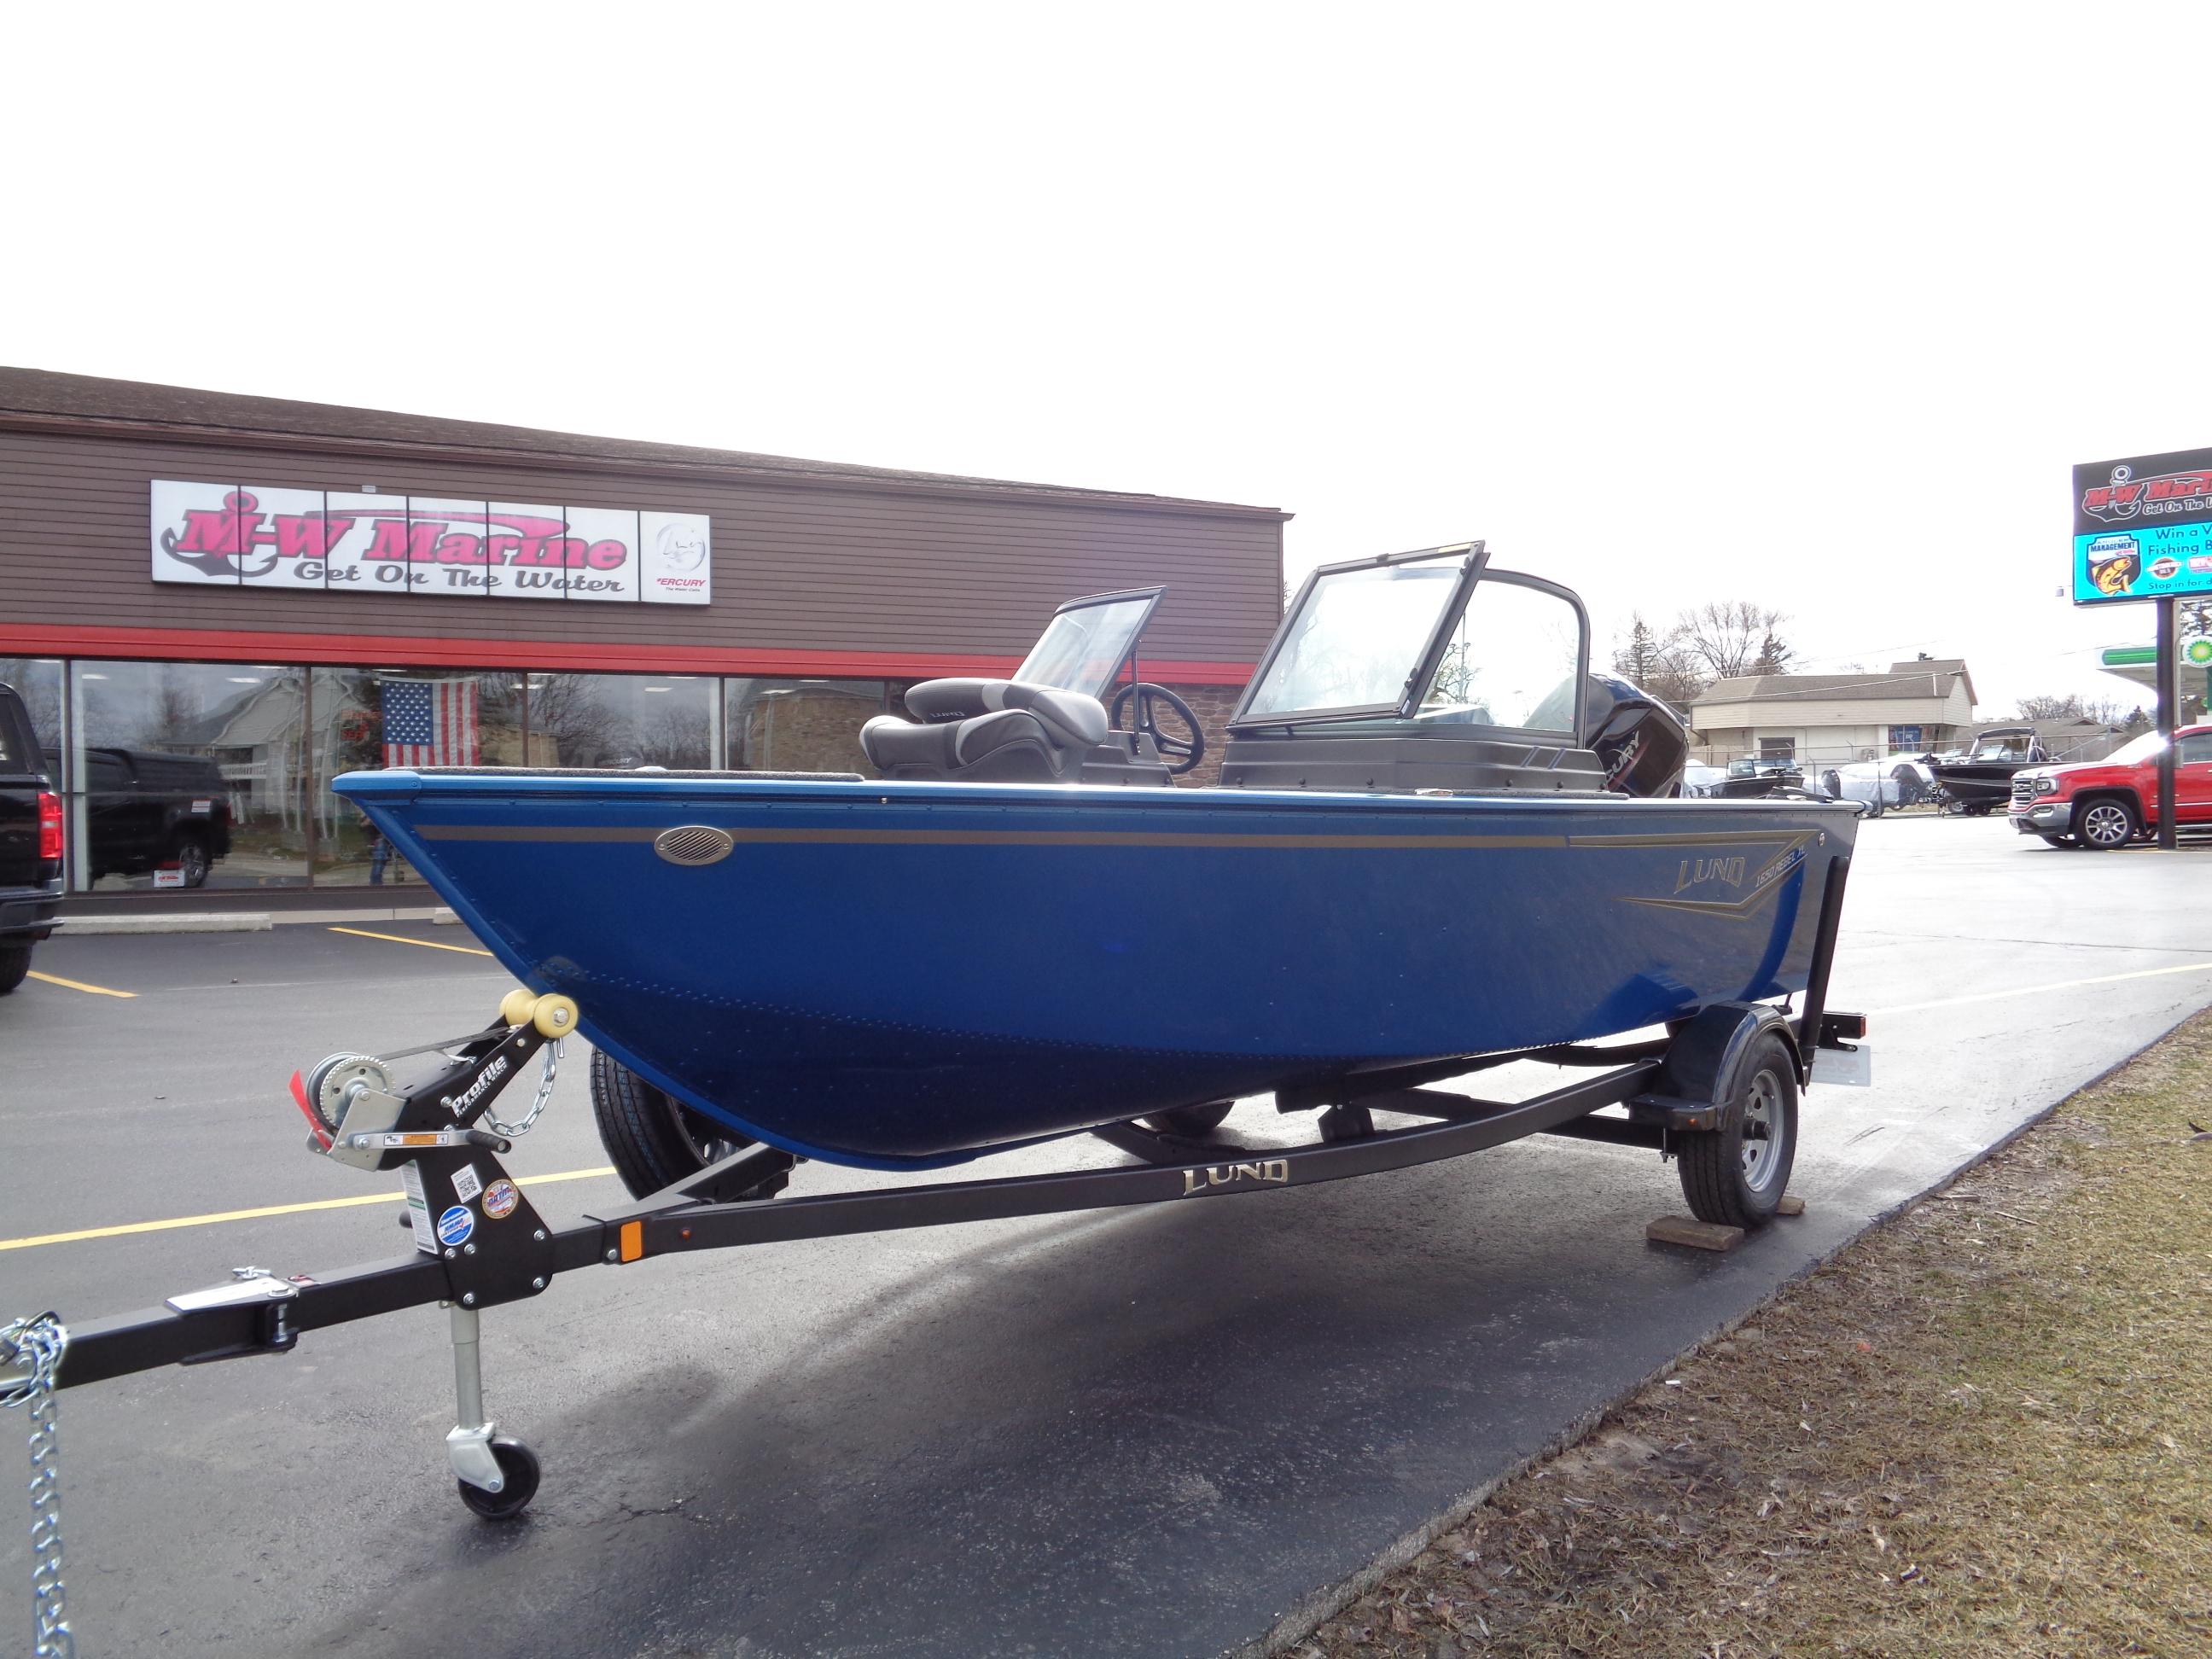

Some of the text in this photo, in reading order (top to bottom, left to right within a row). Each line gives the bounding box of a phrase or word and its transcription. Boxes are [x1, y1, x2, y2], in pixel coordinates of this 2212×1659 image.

[2085, 485, 2143, 507] M-W
[2143, 504, 2163, 515] Get
[2165, 501, 2182, 513] On
[2184, 498, 2204, 510] The
[175, 509, 627, 571] M-W Marine
[2091, 542, 2135, 552] MANAGEMENT
[2156, 528, 2185, 539] Win
[2148, 542, 2199, 556] Fishing
[294, 561, 626, 593] Get On The Water
[2148, 581, 2172, 590] Stop
[1674, 857, 1745, 894] LUND
[451, 1055, 506, 1116] Profile
[457, 1063, 508, 1119] PERFORMANCE WINCH
[1182, 1159, 1289, 1196] LUND
